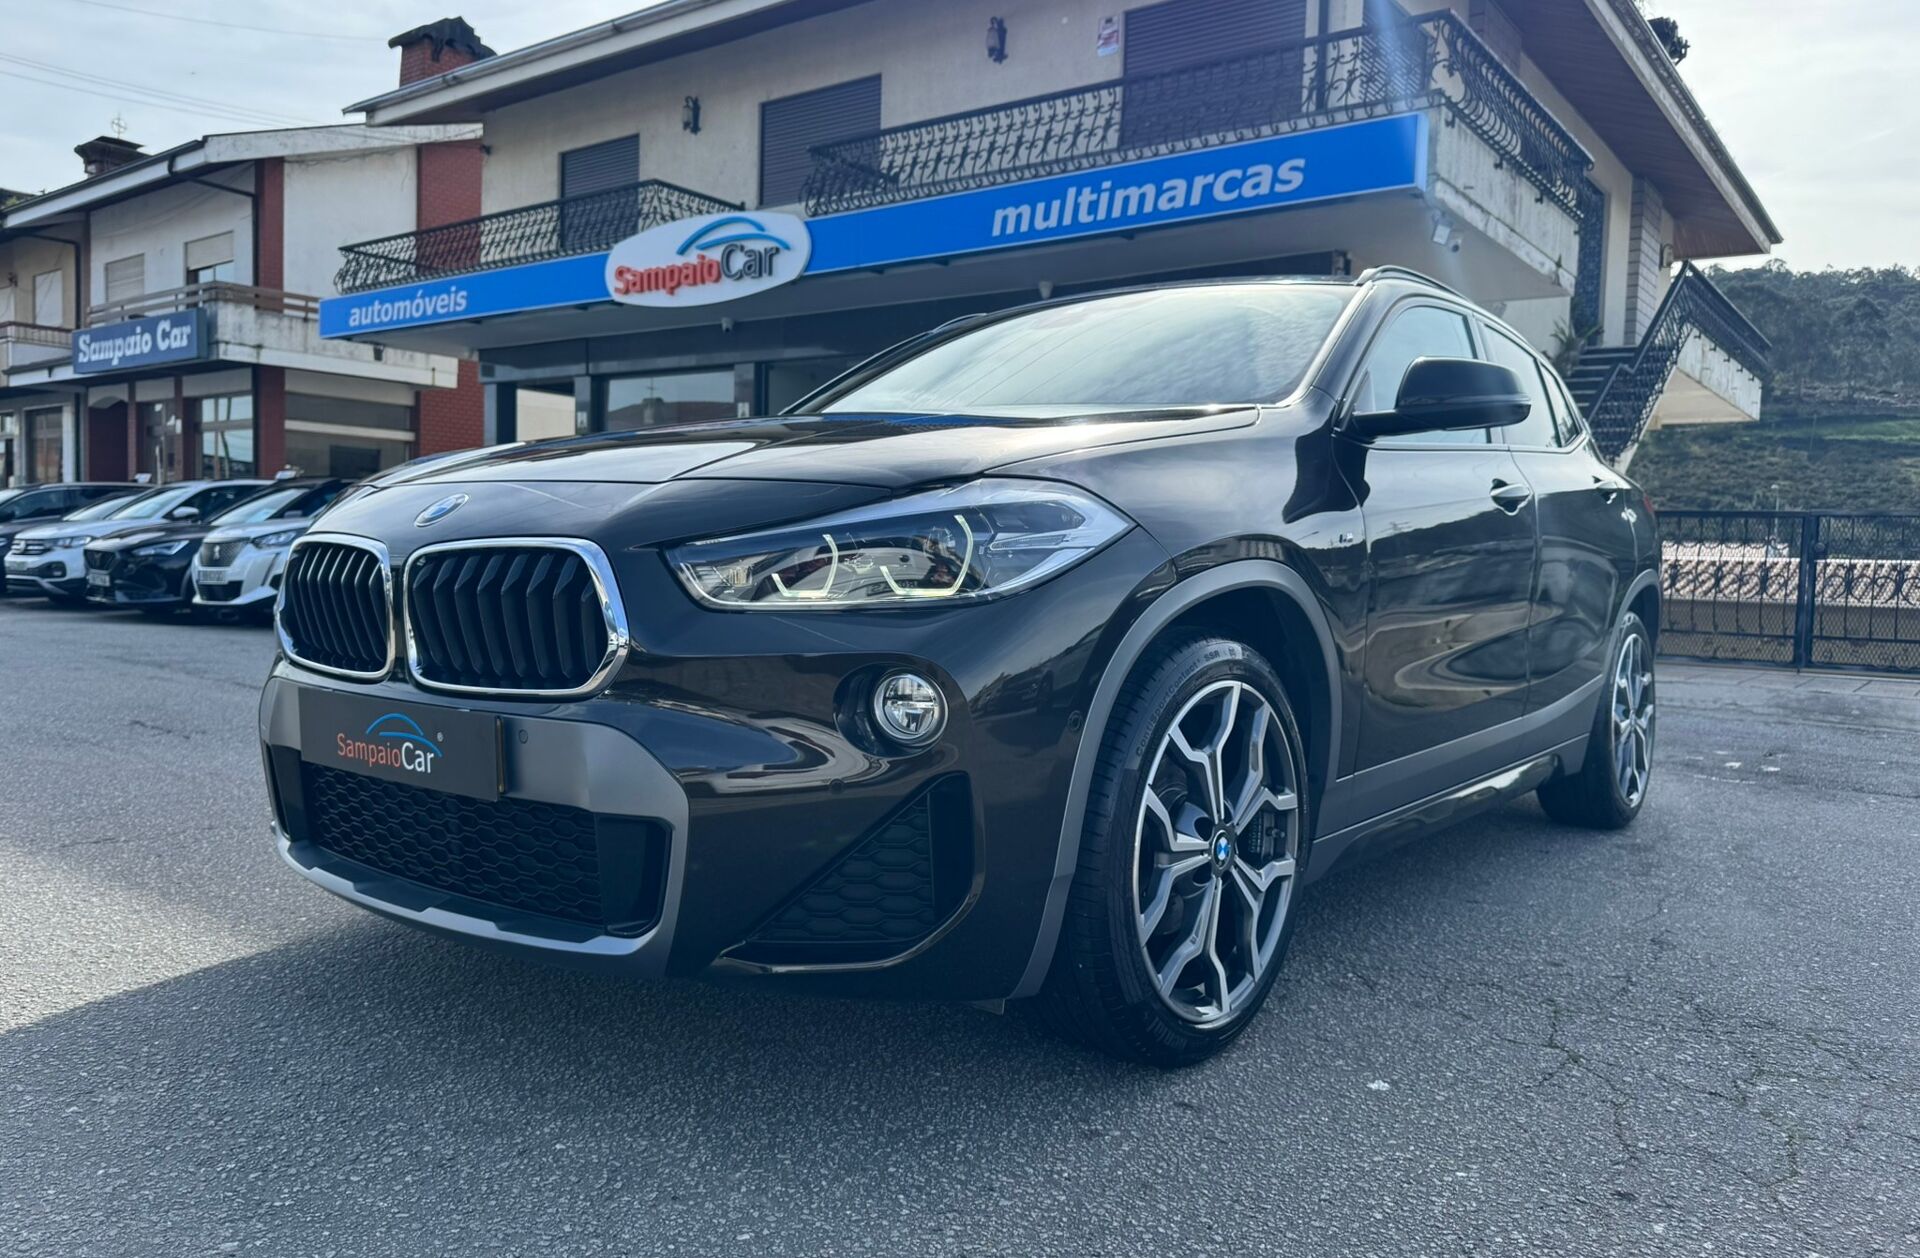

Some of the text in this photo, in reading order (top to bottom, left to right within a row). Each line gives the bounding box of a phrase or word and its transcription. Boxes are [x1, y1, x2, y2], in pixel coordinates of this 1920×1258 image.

[992, 157, 1306, 236] multimarcas
[614, 243, 780, 296] SampaioCar
[348, 285, 467, 327] automóveis
[78, 319, 192, 366] Sampaio Car
[336, 733, 434, 774] SampaioCar
